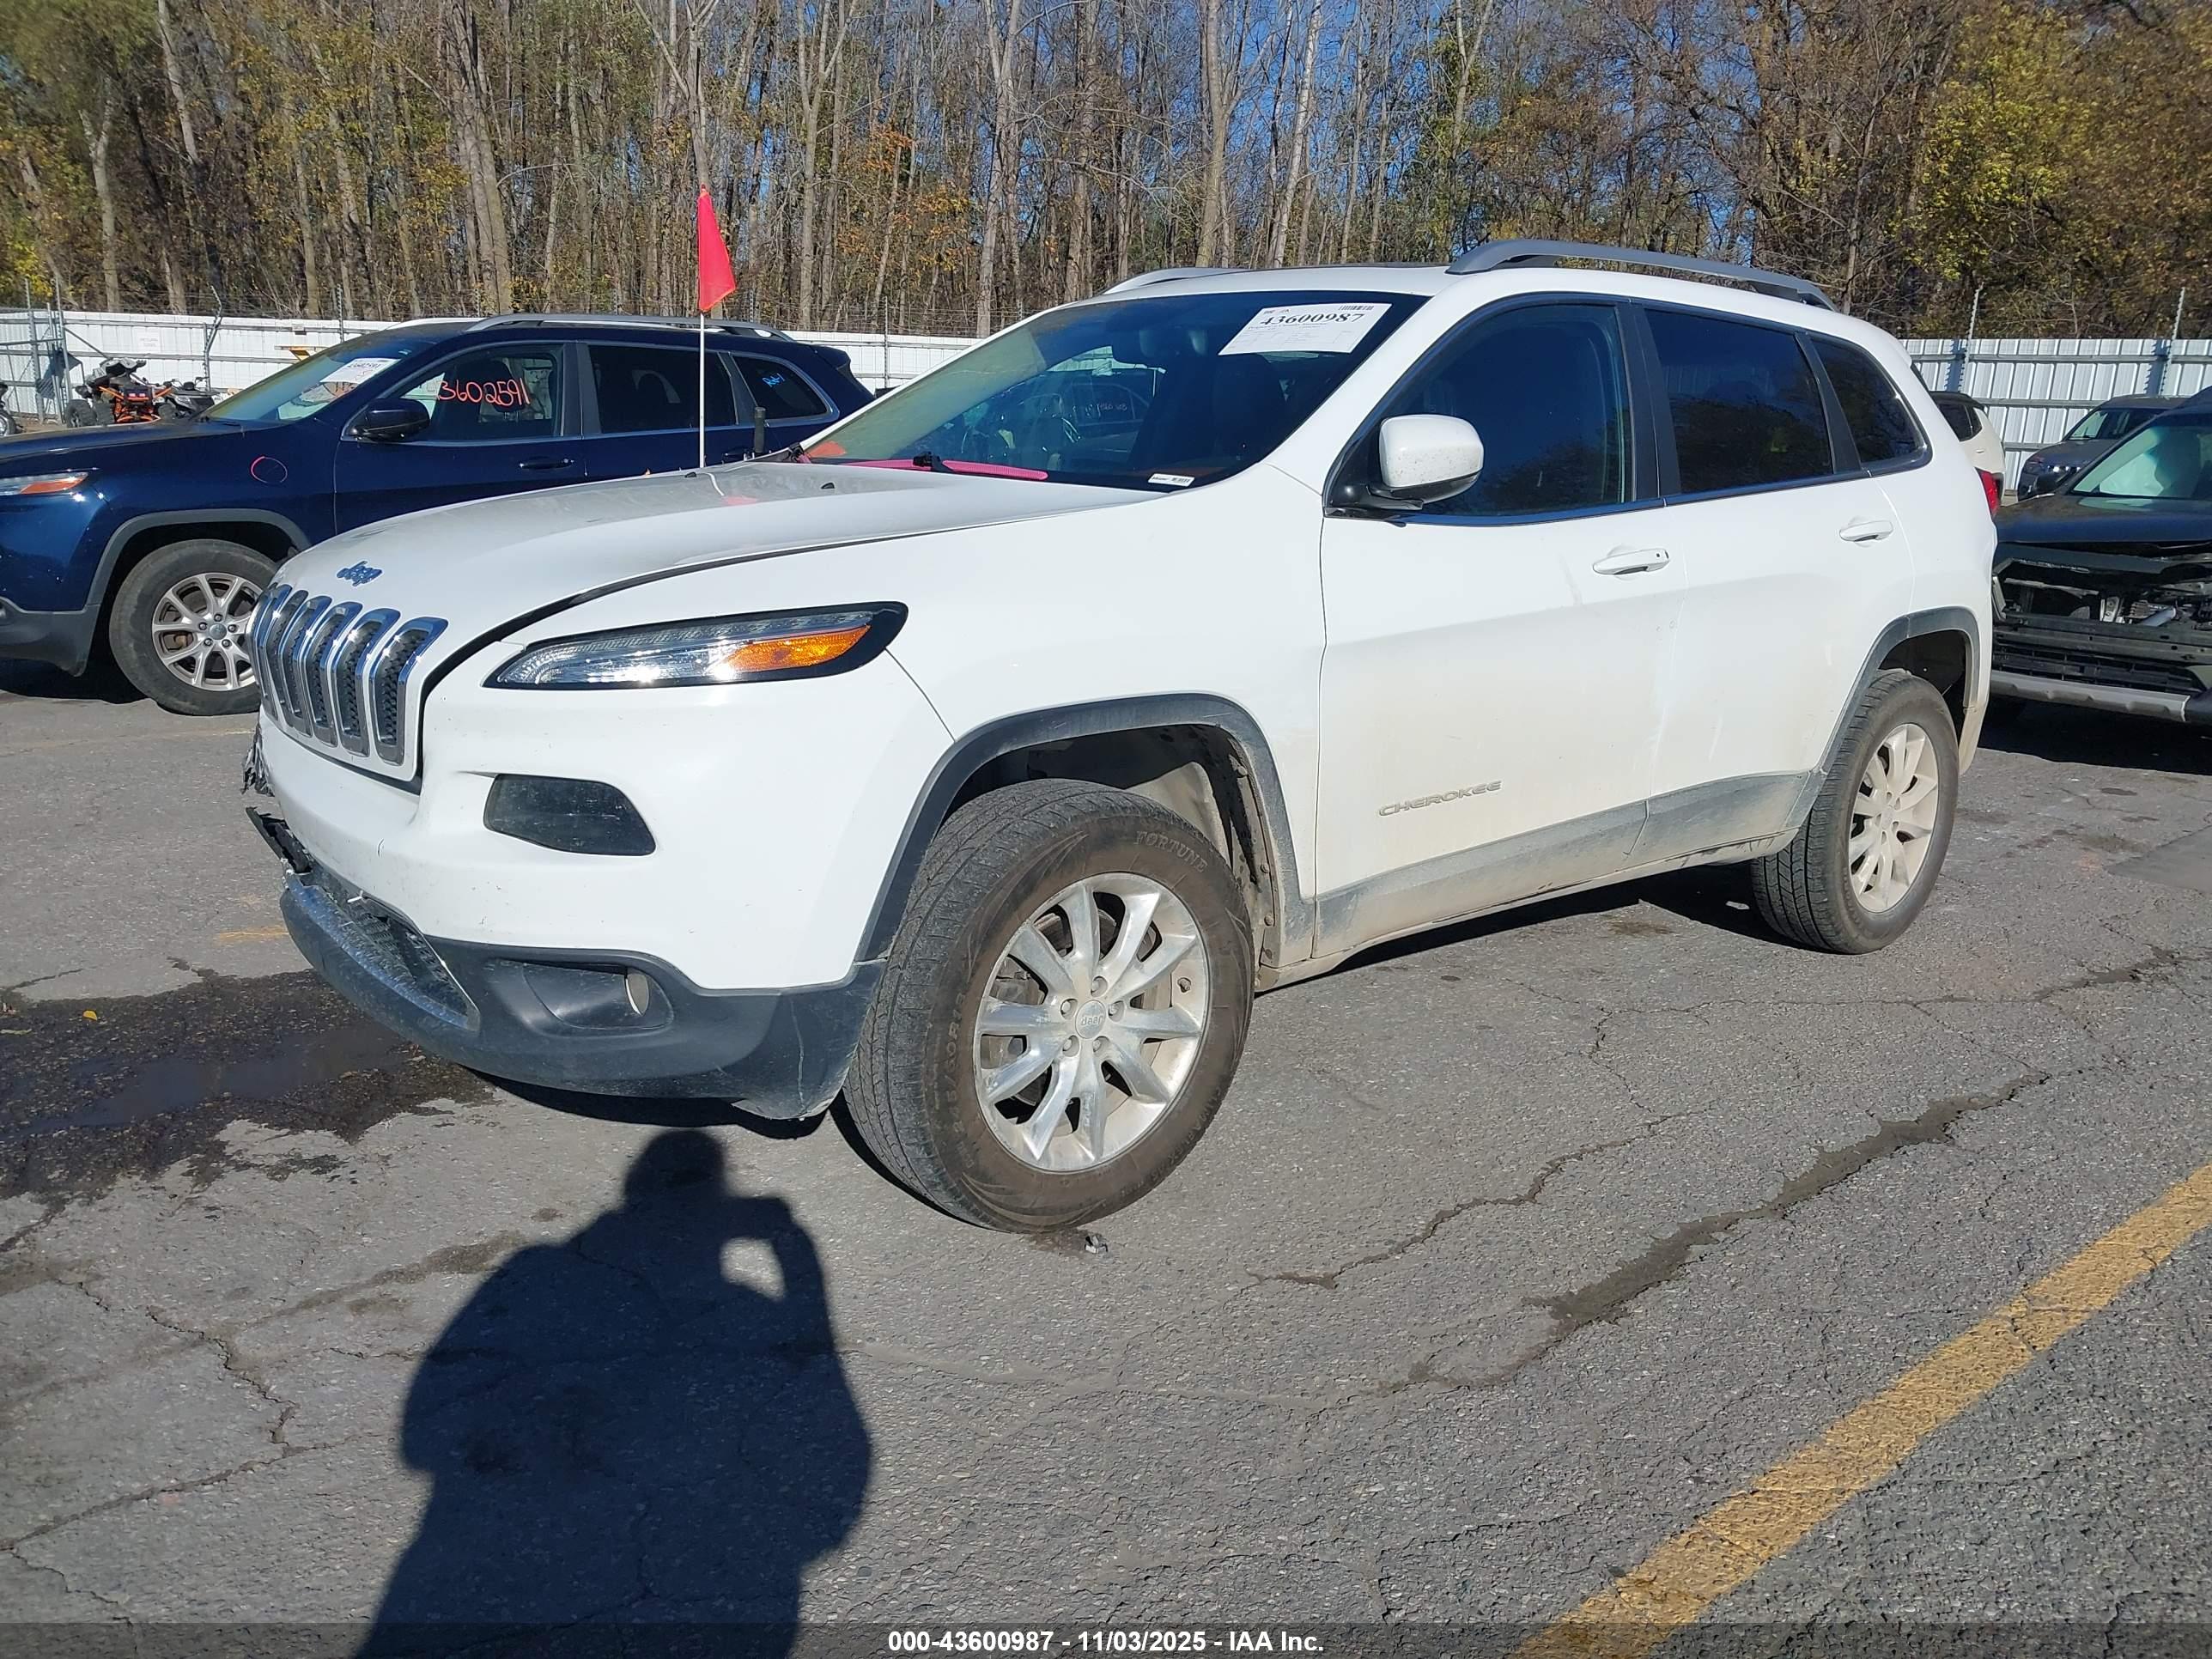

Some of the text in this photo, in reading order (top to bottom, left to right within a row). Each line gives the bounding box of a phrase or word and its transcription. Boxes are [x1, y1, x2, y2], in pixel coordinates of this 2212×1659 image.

[1260, 313, 1365, 325] 43600987
[1378, 780, 1503, 817] CHEROKEE
[1133, 830, 1208, 873] FORTUNE
